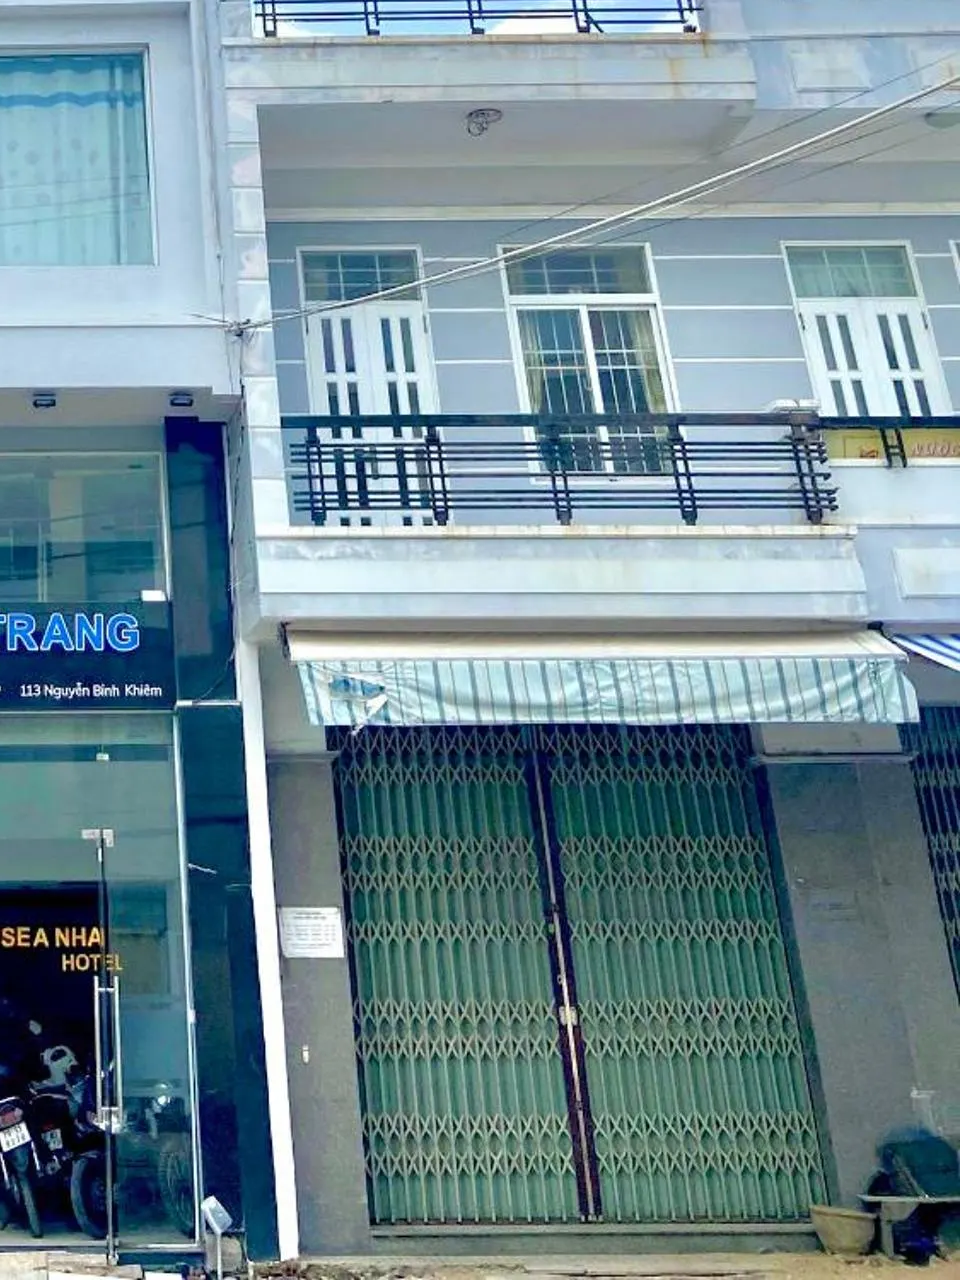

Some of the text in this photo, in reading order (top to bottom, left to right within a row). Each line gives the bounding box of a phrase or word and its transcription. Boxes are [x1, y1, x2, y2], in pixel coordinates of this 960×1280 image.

[20, 684, 41, 697] 113
[124, 684, 162, 697] Khiêm
[54, 926, 102, 948] NHA
